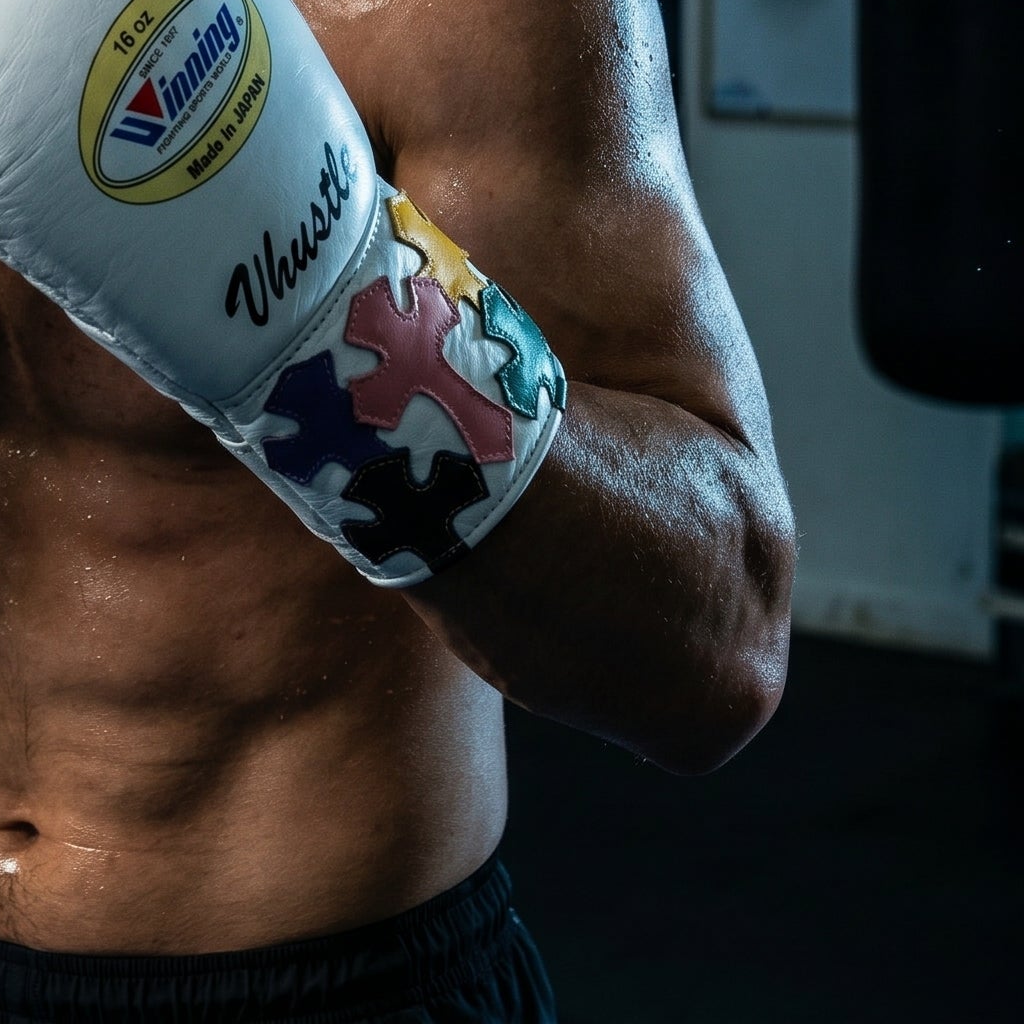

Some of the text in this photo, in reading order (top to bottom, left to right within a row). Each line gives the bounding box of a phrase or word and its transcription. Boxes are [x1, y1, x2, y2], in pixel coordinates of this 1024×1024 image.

[113, 30, 136, 56] 16
[138, 48, 164, 80] SINCE
[109, 2, 241, 148] Winning
[233, 73, 266, 125] JAPAN
